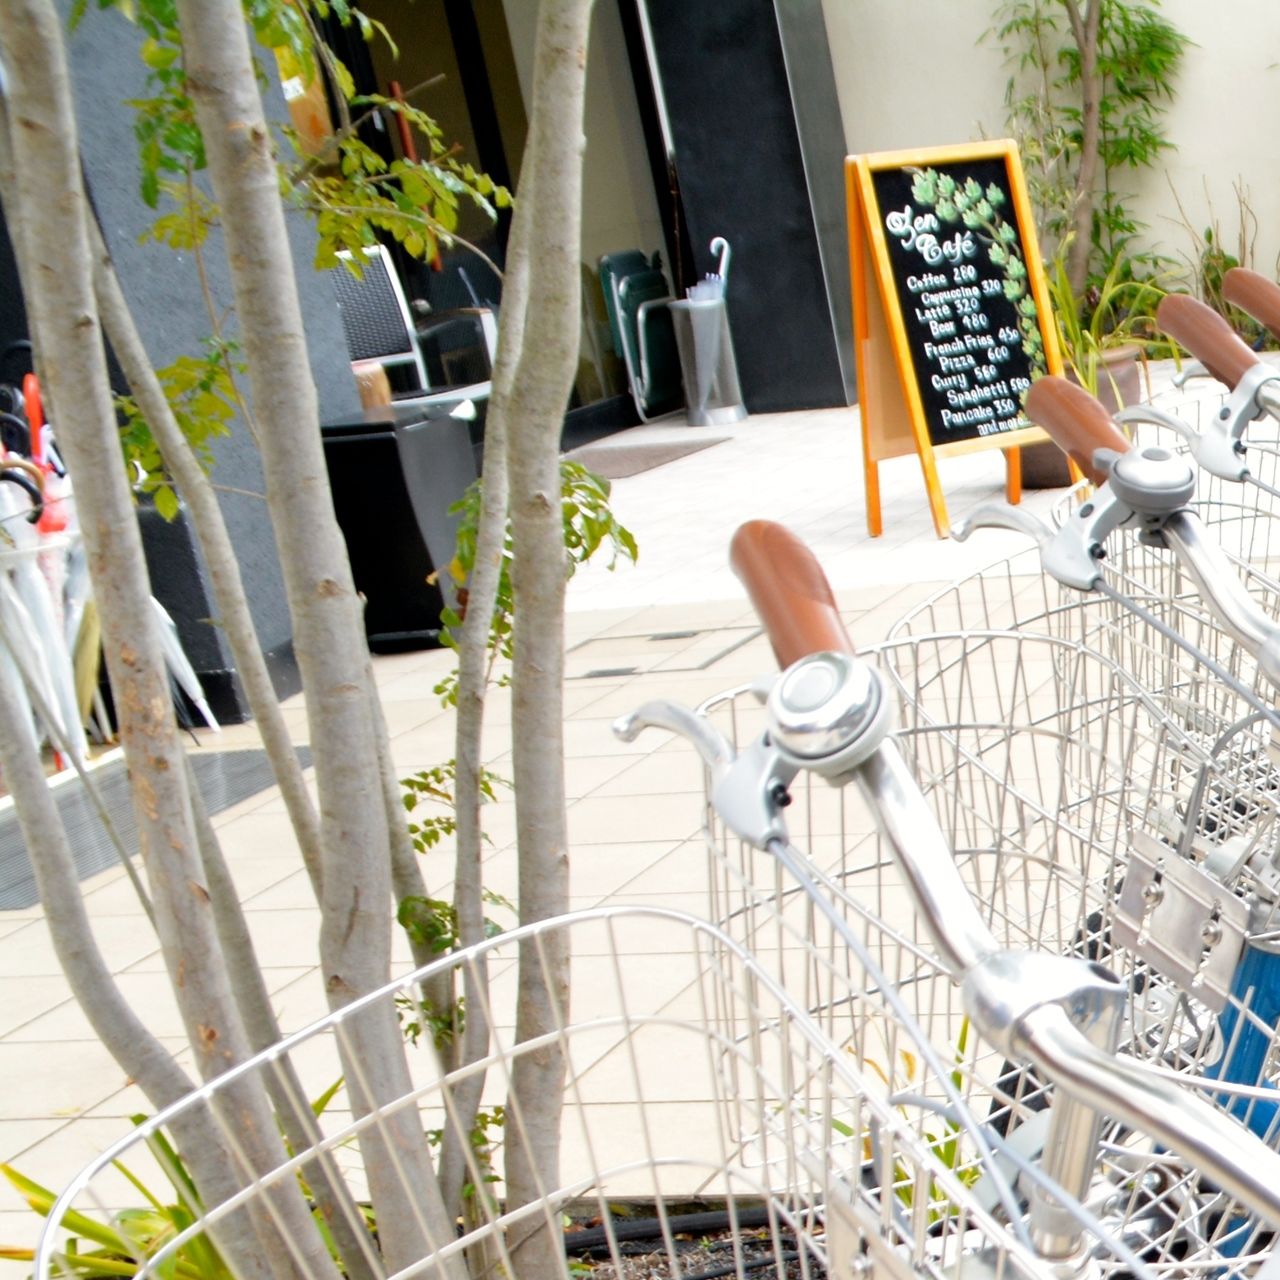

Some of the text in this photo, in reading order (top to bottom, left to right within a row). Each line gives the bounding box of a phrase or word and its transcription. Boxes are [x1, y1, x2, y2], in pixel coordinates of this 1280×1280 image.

[886, 205, 940, 250] Zen
[915, 230, 977, 266] Café
[906, 264, 978, 293] Coffee 280
[921, 279, 1003, 307] Cappuccino 320
[915, 298, 980, 323] Latte 320
[923, 326, 1020, 359] French Fries 450
[929, 319, 956, 338] Beer
[938, 345, 1010, 373] Pizza 600
[931, 372, 968, 392] Curry
[946, 380, 1010, 408] Spaghetti
[940, 398, 1017, 430] Pancake 350
[976, 419, 1000, 437] and
